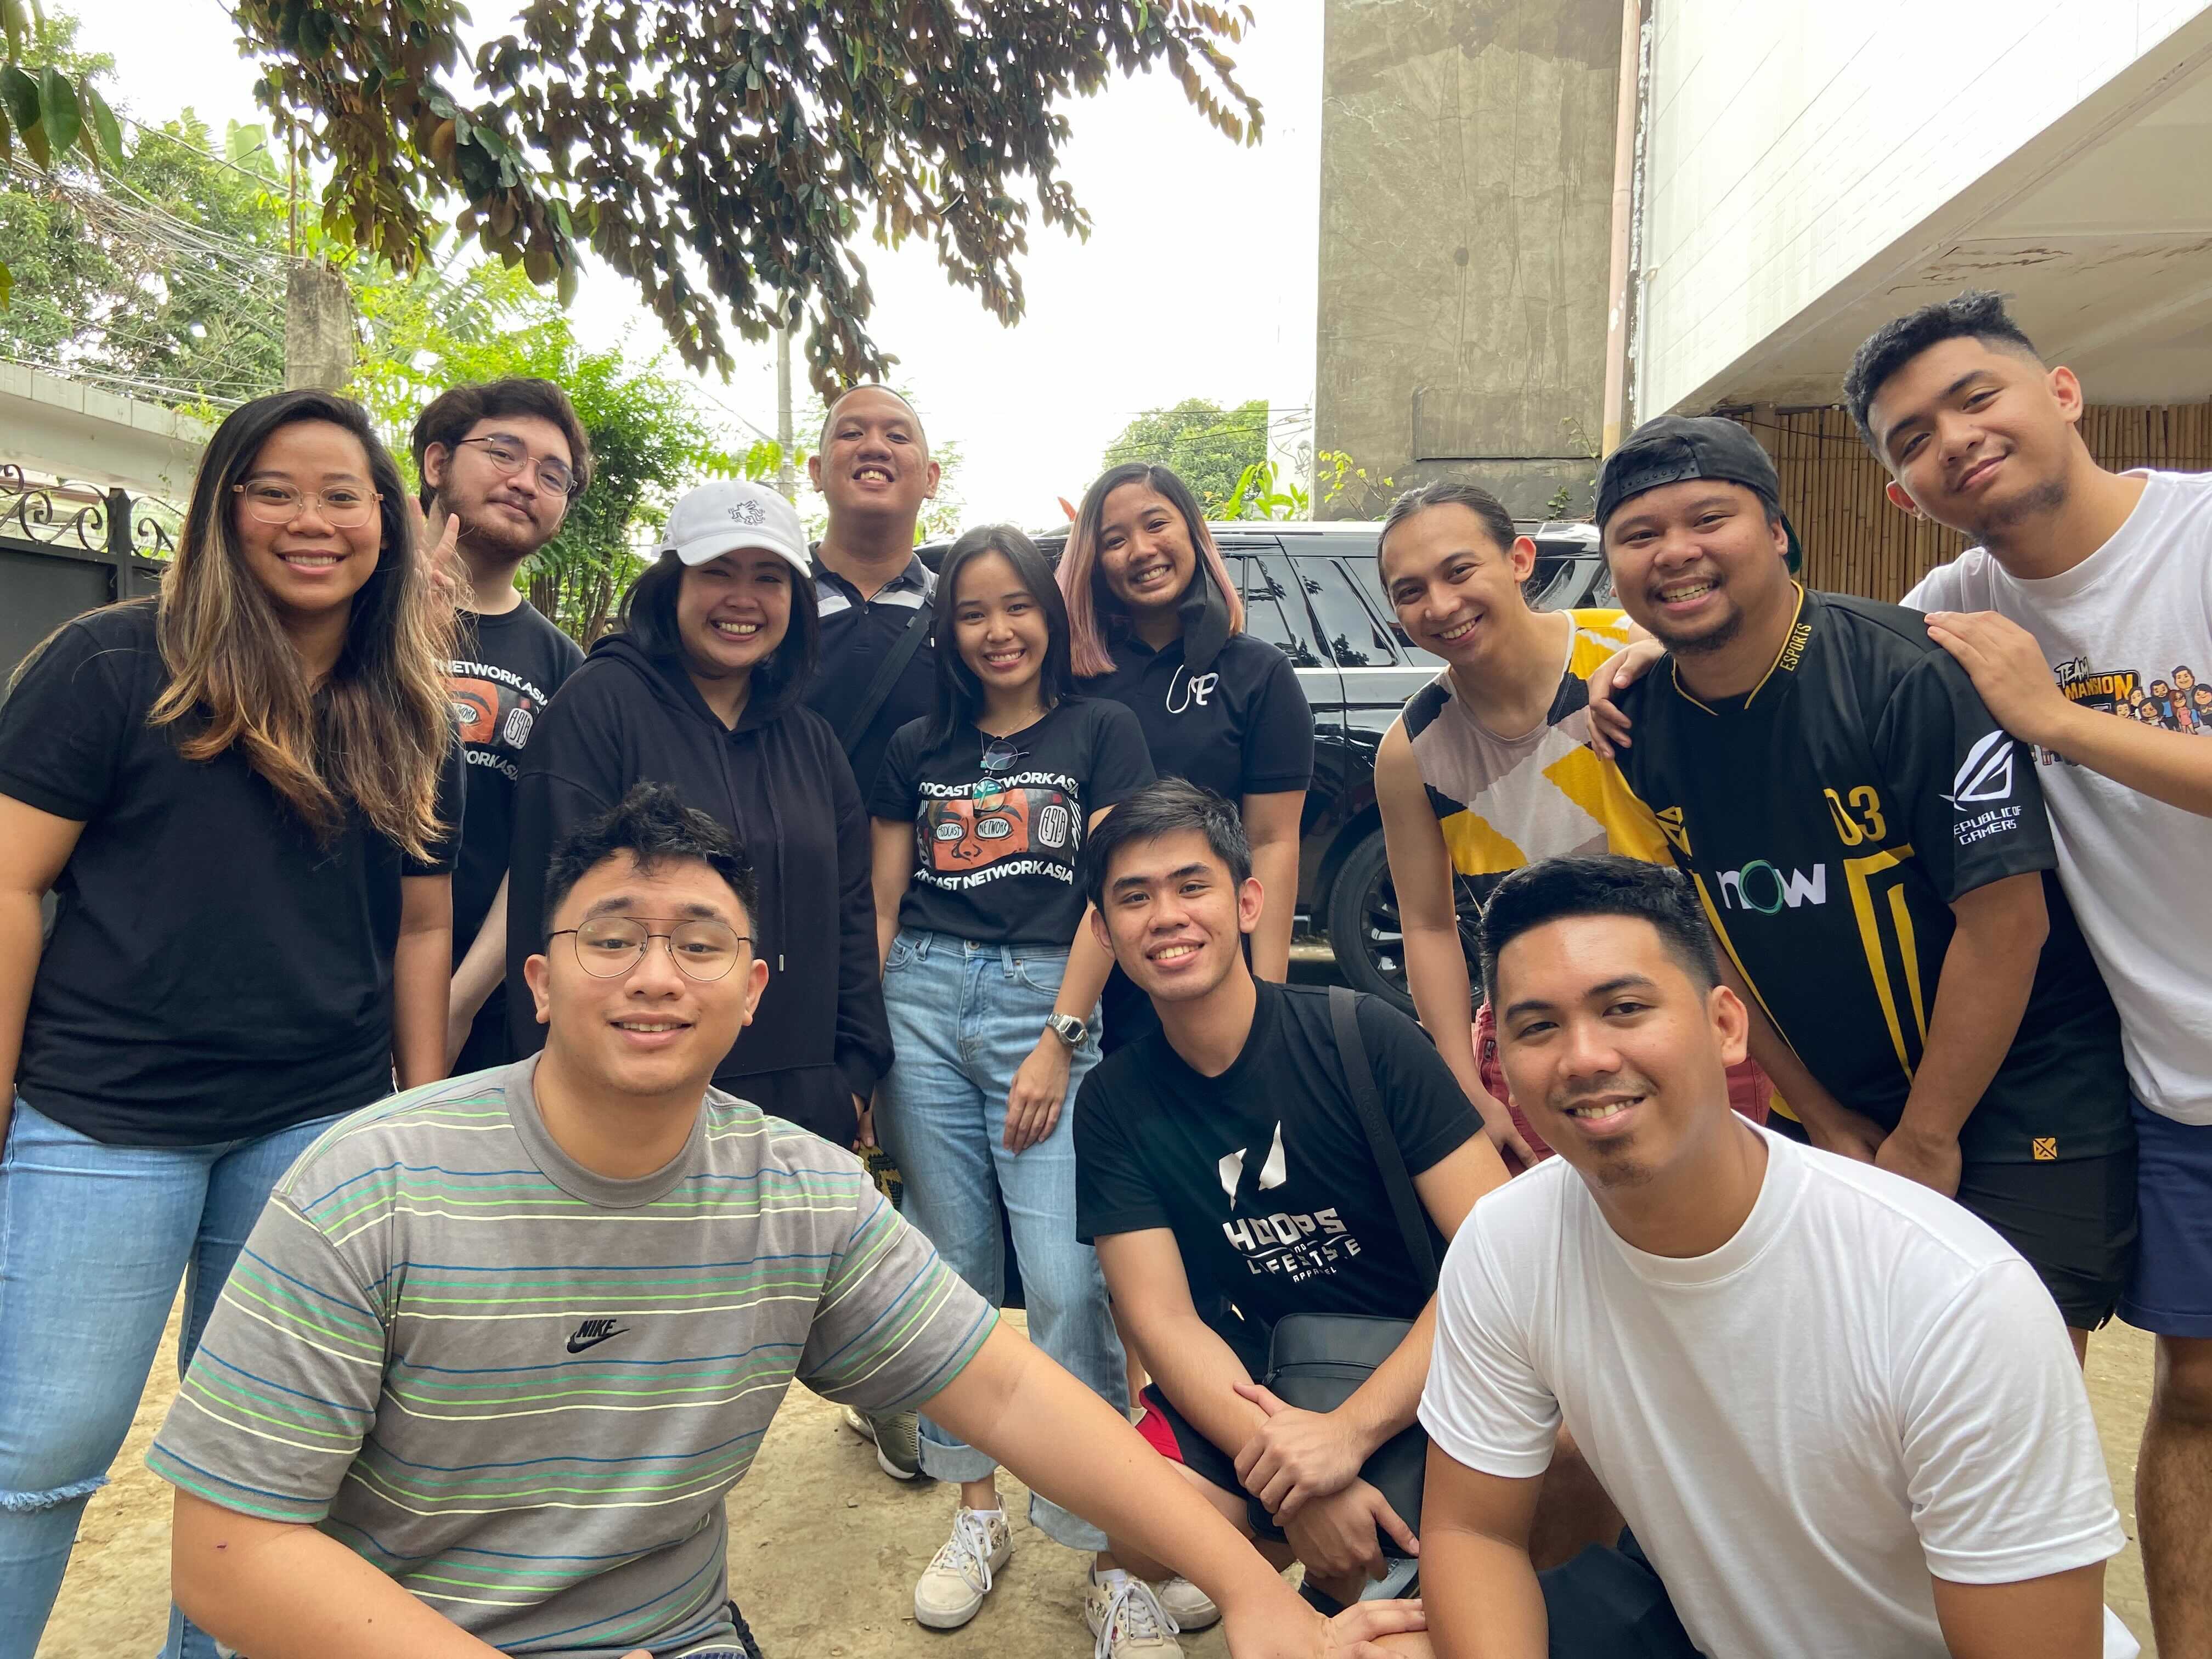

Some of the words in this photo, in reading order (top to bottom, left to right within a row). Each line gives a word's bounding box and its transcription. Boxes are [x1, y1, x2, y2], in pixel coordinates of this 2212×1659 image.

[1779, 623, 1812, 672] ESPORTS
[2055, 657, 2089, 688] TEAM
[2064, 674, 2133, 701] MANSION
[938, 826, 960, 837] PODCAST
[979, 820, 1008, 834] NETWORK
[1040, 807, 1066, 843] ASIA
[1824, 786, 1886, 845] 03
[1954, 807, 2012, 835] EPUBLIC
[2012, 805, 2022, 816] OF
[1959, 819, 2017, 845] GAMERS
[963, 860, 1043, 889] NETWORK
[1042, 861, 1074, 885] ASIA
[1222, 1207, 1347, 1251] HOOPS
[1293, 1266, 1337, 1283] APPAEL
[576, 1319, 617, 1338] NIKE
